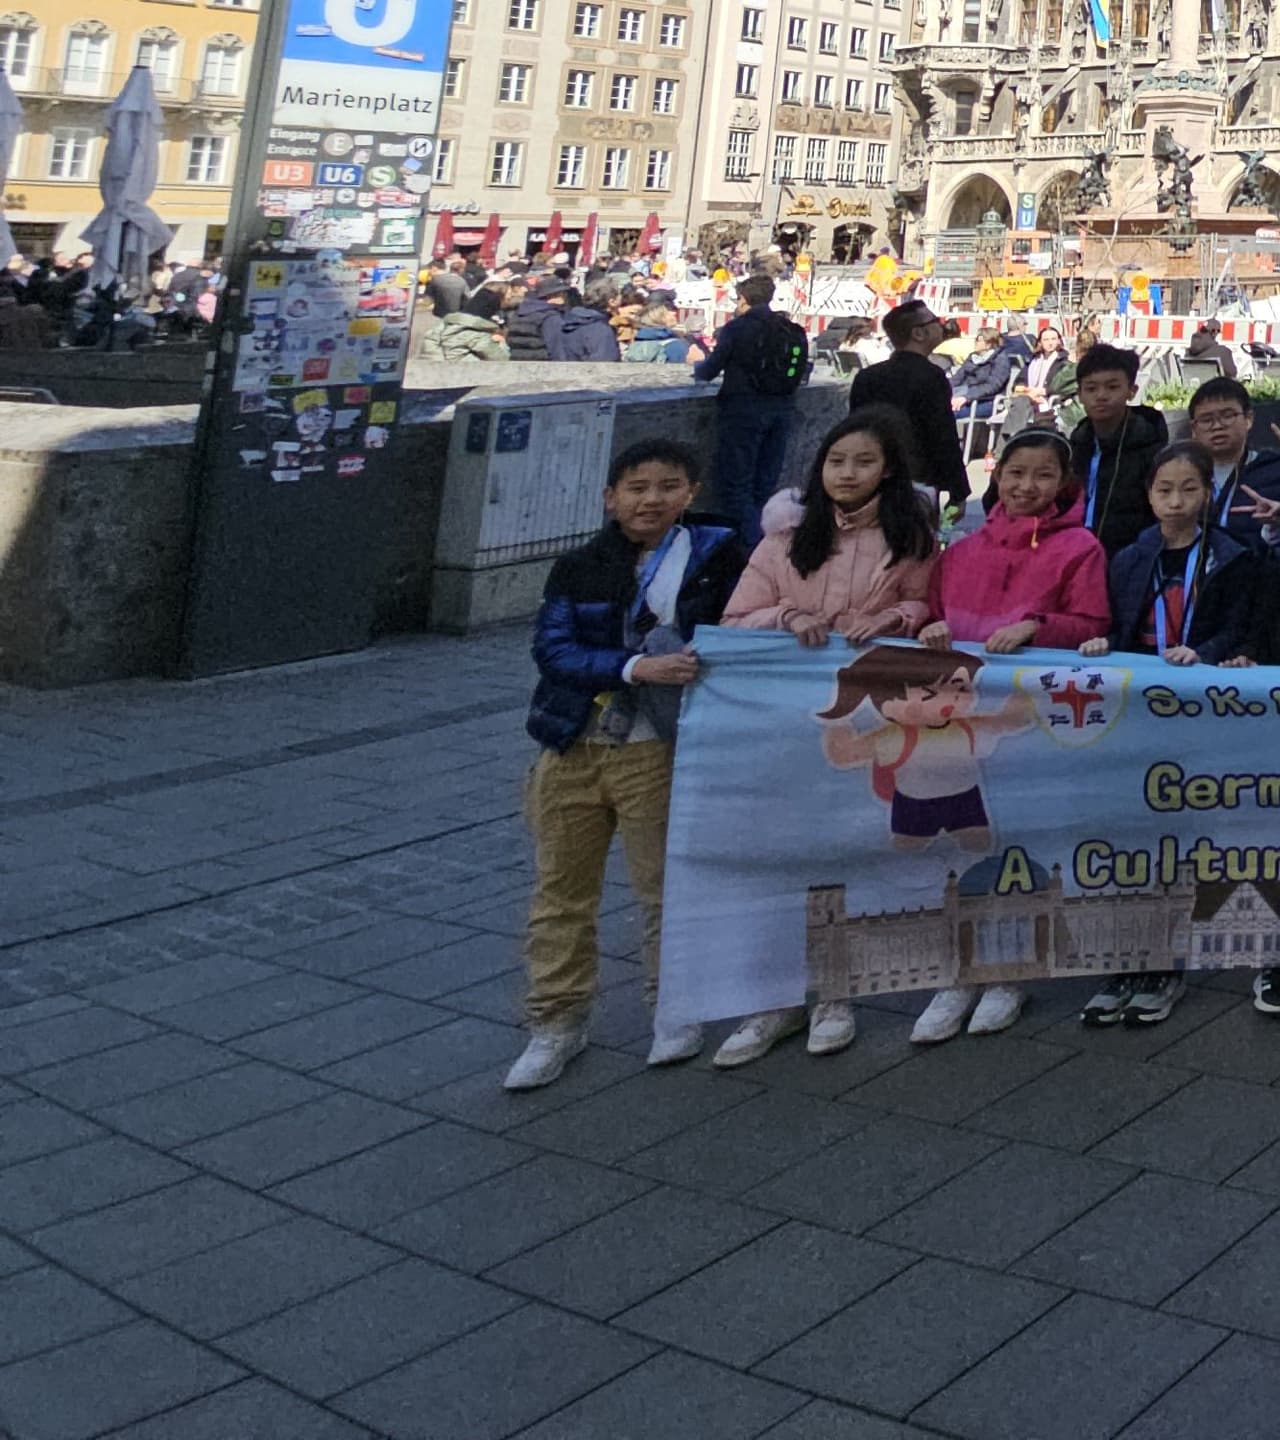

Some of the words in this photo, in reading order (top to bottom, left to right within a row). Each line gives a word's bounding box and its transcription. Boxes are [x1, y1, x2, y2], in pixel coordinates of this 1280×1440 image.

[281, 85, 433, 114] Marienplatz
[269, 128, 320, 143] Eingang
[273, 165, 305, 181] U3
[324, 166, 356, 183] U6
[1022, 194, 1034, 209] S
[1021, 211, 1032, 225] U
[995, 845, 1036, 896] A
